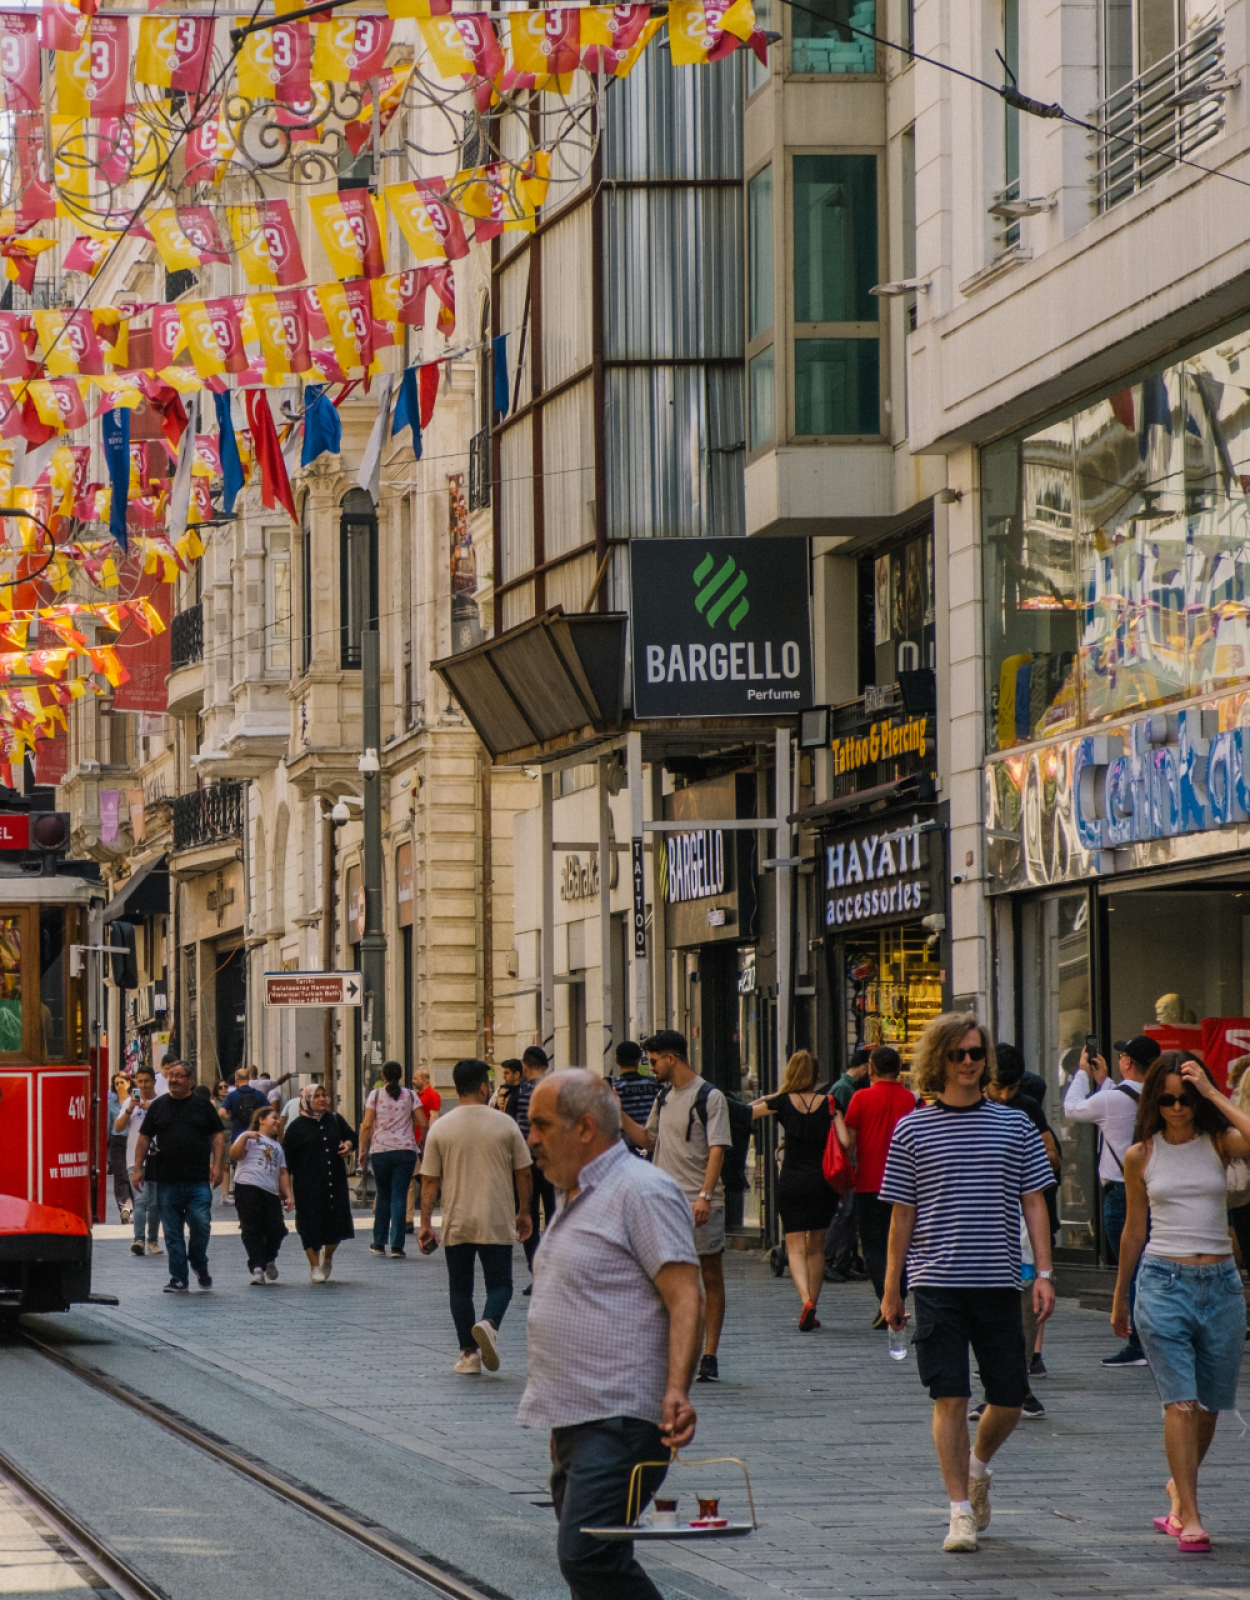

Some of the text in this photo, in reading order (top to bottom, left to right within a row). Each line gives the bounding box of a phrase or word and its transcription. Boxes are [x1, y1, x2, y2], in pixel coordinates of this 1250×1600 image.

[156, 18, 194, 52] 23
[336, 19, 372, 52] 23
[439, 19, 480, 47] 23
[529, 10, 562, 34] 23
[74, 41, 110, 78] 23
[255, 29, 291, 65] 23
[335, 217, 366, 247] 23
[416, 205, 447, 231] 23
[253, 229, 283, 256] 23
[202, 326, 231, 348] 23
[269, 316, 297, 345] 23
[338, 307, 367, 339] 23
[56, 326, 85, 352] 23
[646, 641, 800, 683] BARGELLO
[747, 688, 801, 701] Perfume
[832, 715, 927, 776] Tattoo & Piercing
[668, 829, 725, 904] BARGELLO
[634, 843, 645, 946] TATTOO
[826, 880, 921, 925] accessories
[301, 990, 324, 998] Turkish
[68, 1095, 86, 1120] 410
